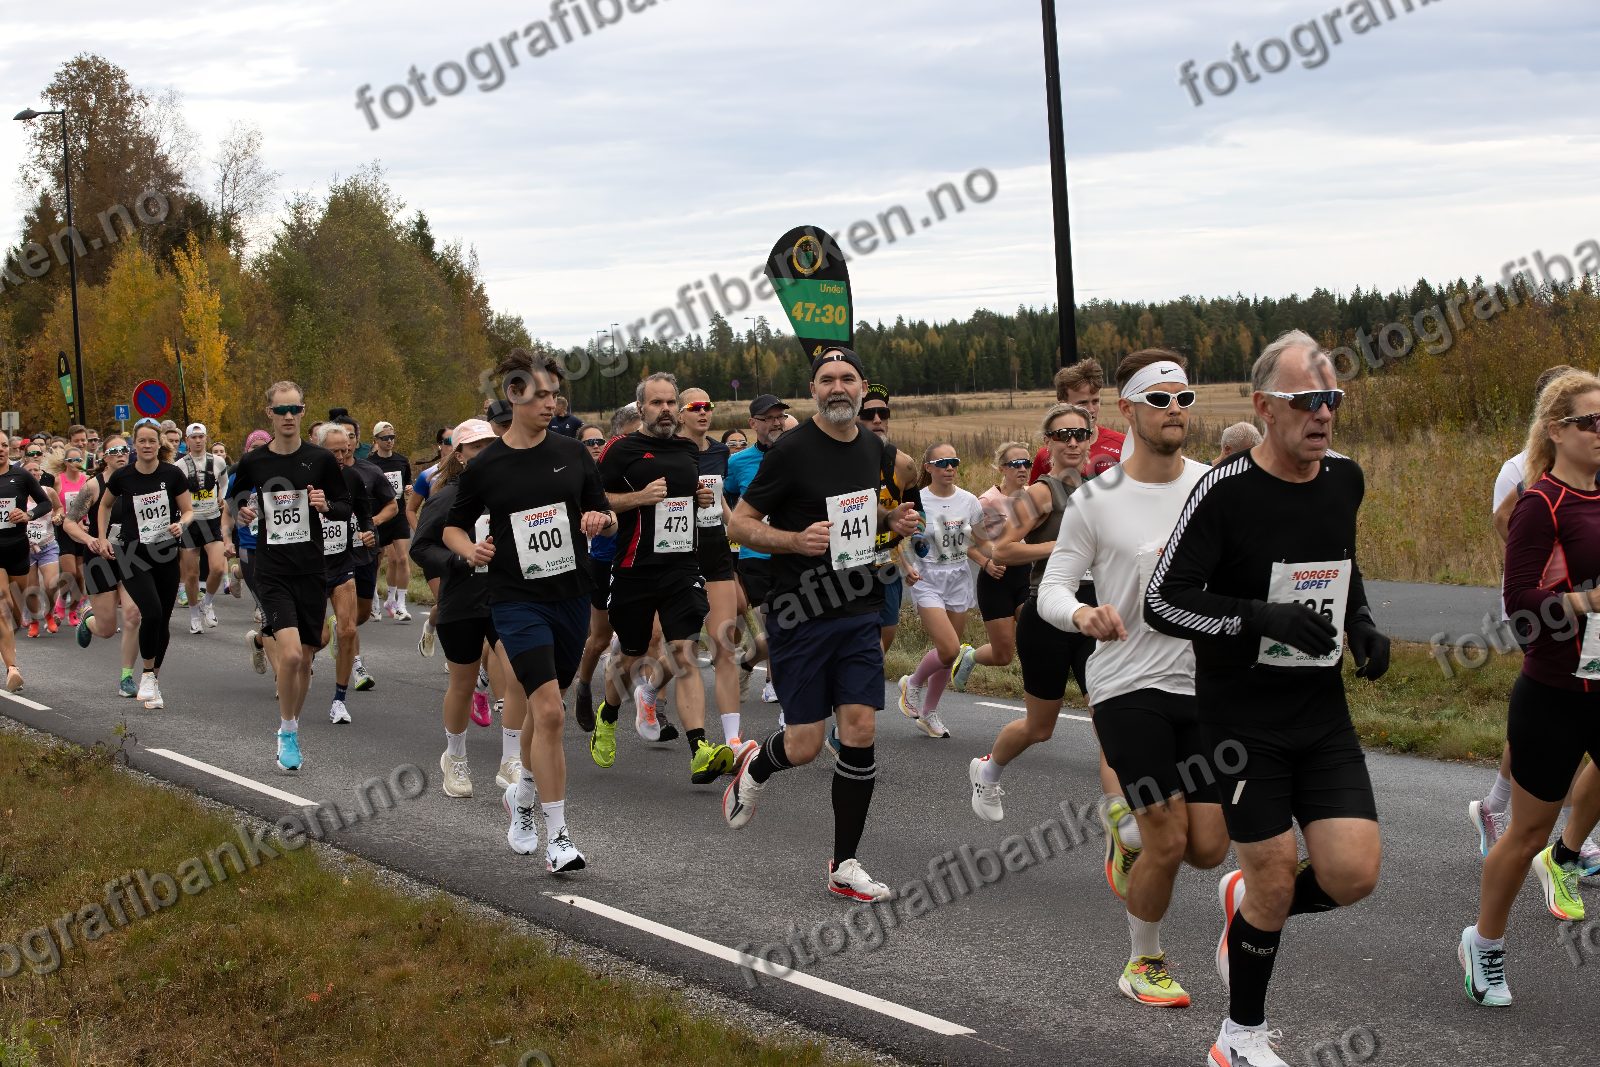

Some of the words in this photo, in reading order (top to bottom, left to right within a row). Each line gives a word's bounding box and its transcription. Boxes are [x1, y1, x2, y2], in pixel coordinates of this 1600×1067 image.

[820, 284, 844, 294] Under
[791, 302, 847, 325] 47:30
[839, 494, 869, 507] NORGES
[842, 502, 865, 513] LØPET
[139, 504, 167, 521] 1012
[273, 508, 301, 525] 565
[523, 508, 558, 523] NORGES
[528, 517, 554, 528] LØPET
[663, 515, 688, 533] 473
[840, 514, 870, 541] 441
[321, 524, 342, 540] 568
[942, 532, 965, 548] 810
[528, 527, 564, 554] 400
[1291, 568, 1340, 581] NORGES
[1294, 579, 1332, 591] LØPET
